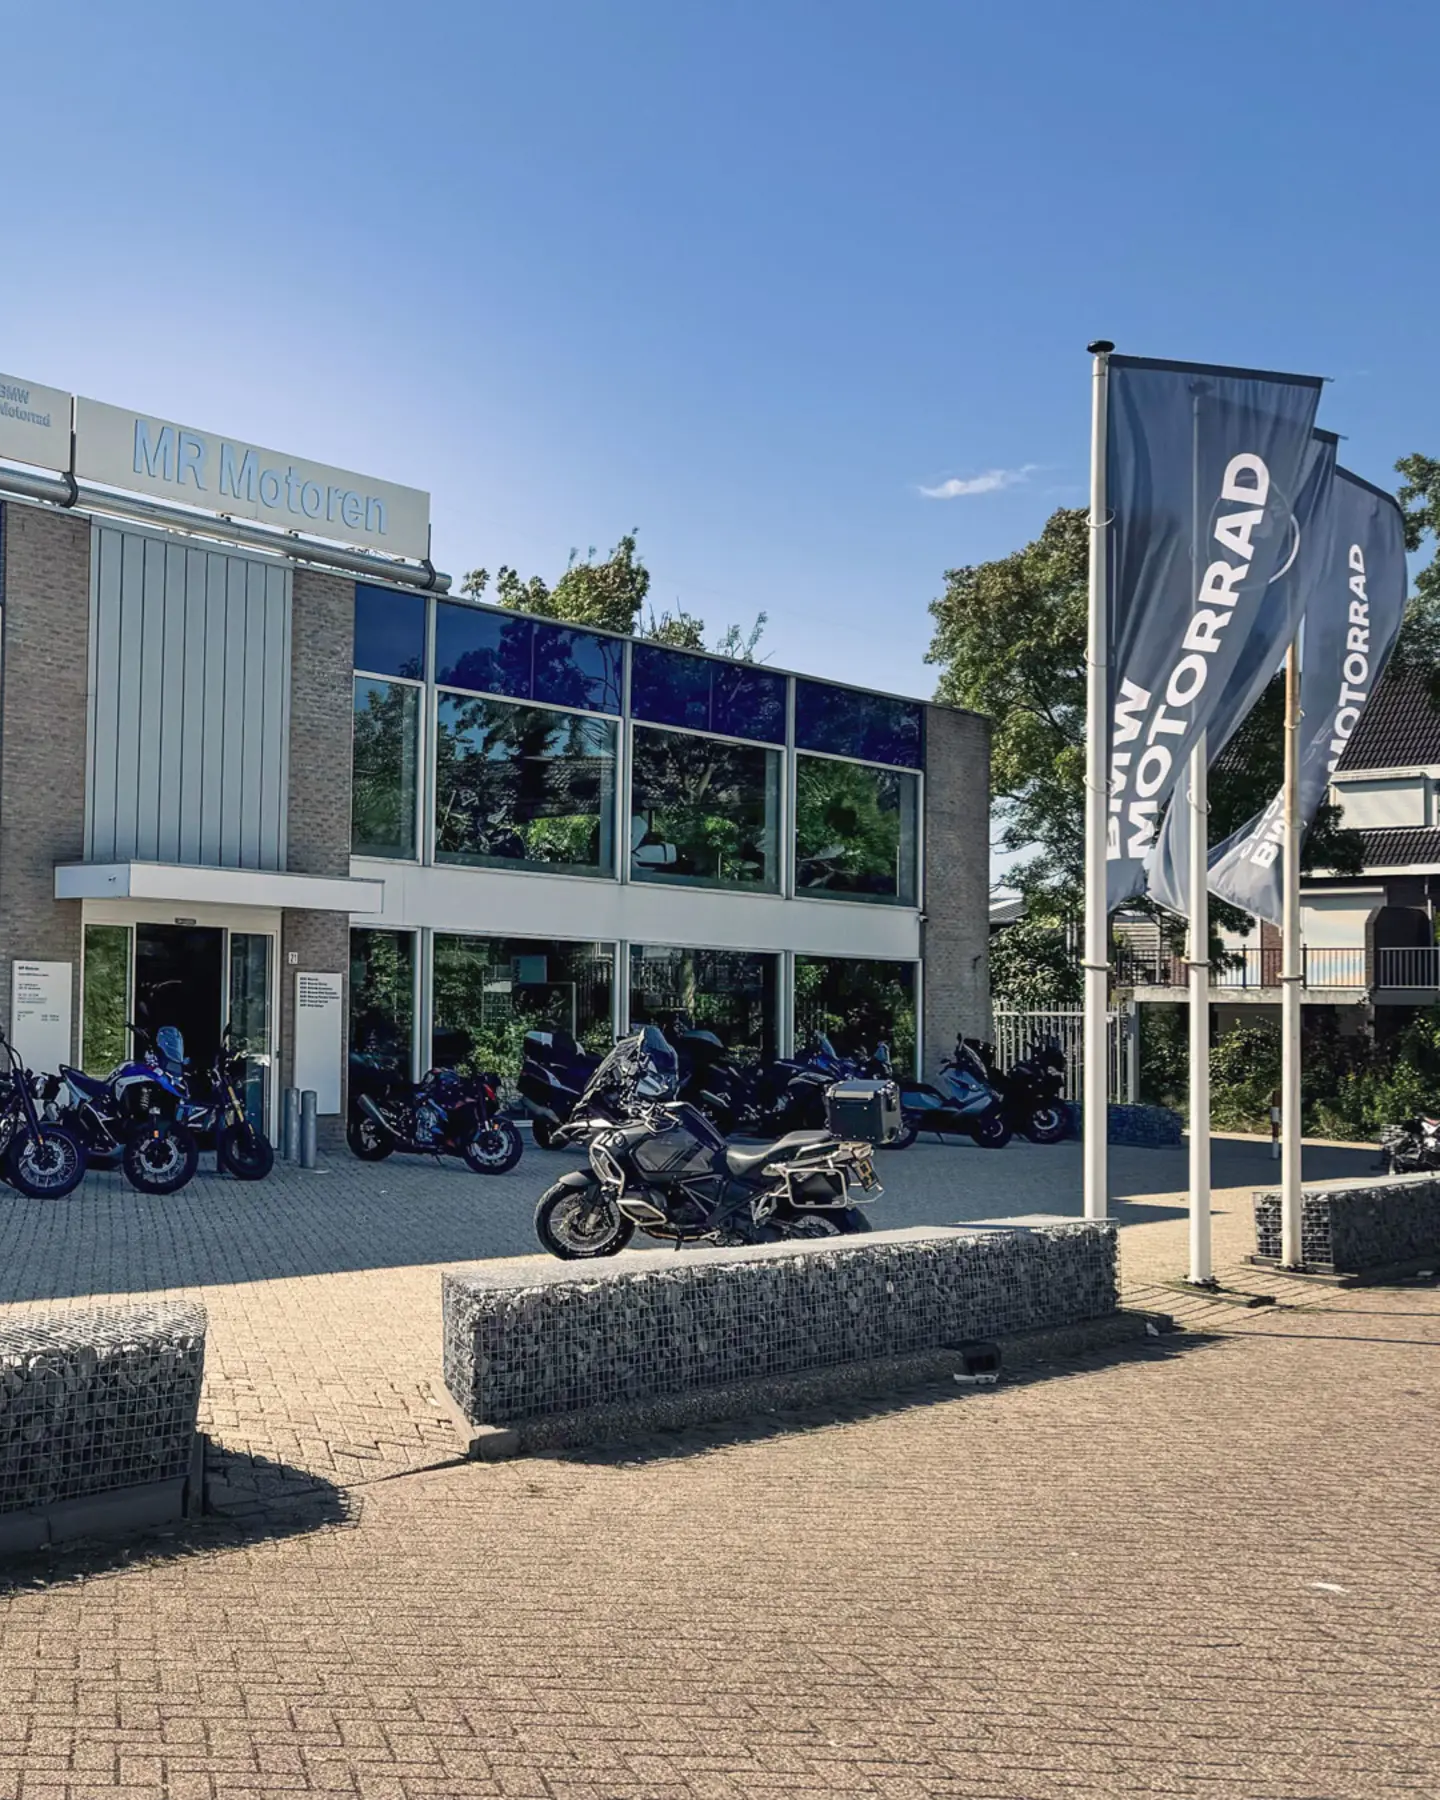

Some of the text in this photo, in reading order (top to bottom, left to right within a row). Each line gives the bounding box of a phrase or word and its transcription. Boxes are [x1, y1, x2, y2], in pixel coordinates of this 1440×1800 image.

[133, 418, 389, 536] MR Motoren
[1128, 452, 1271, 859] MOTORRAD
